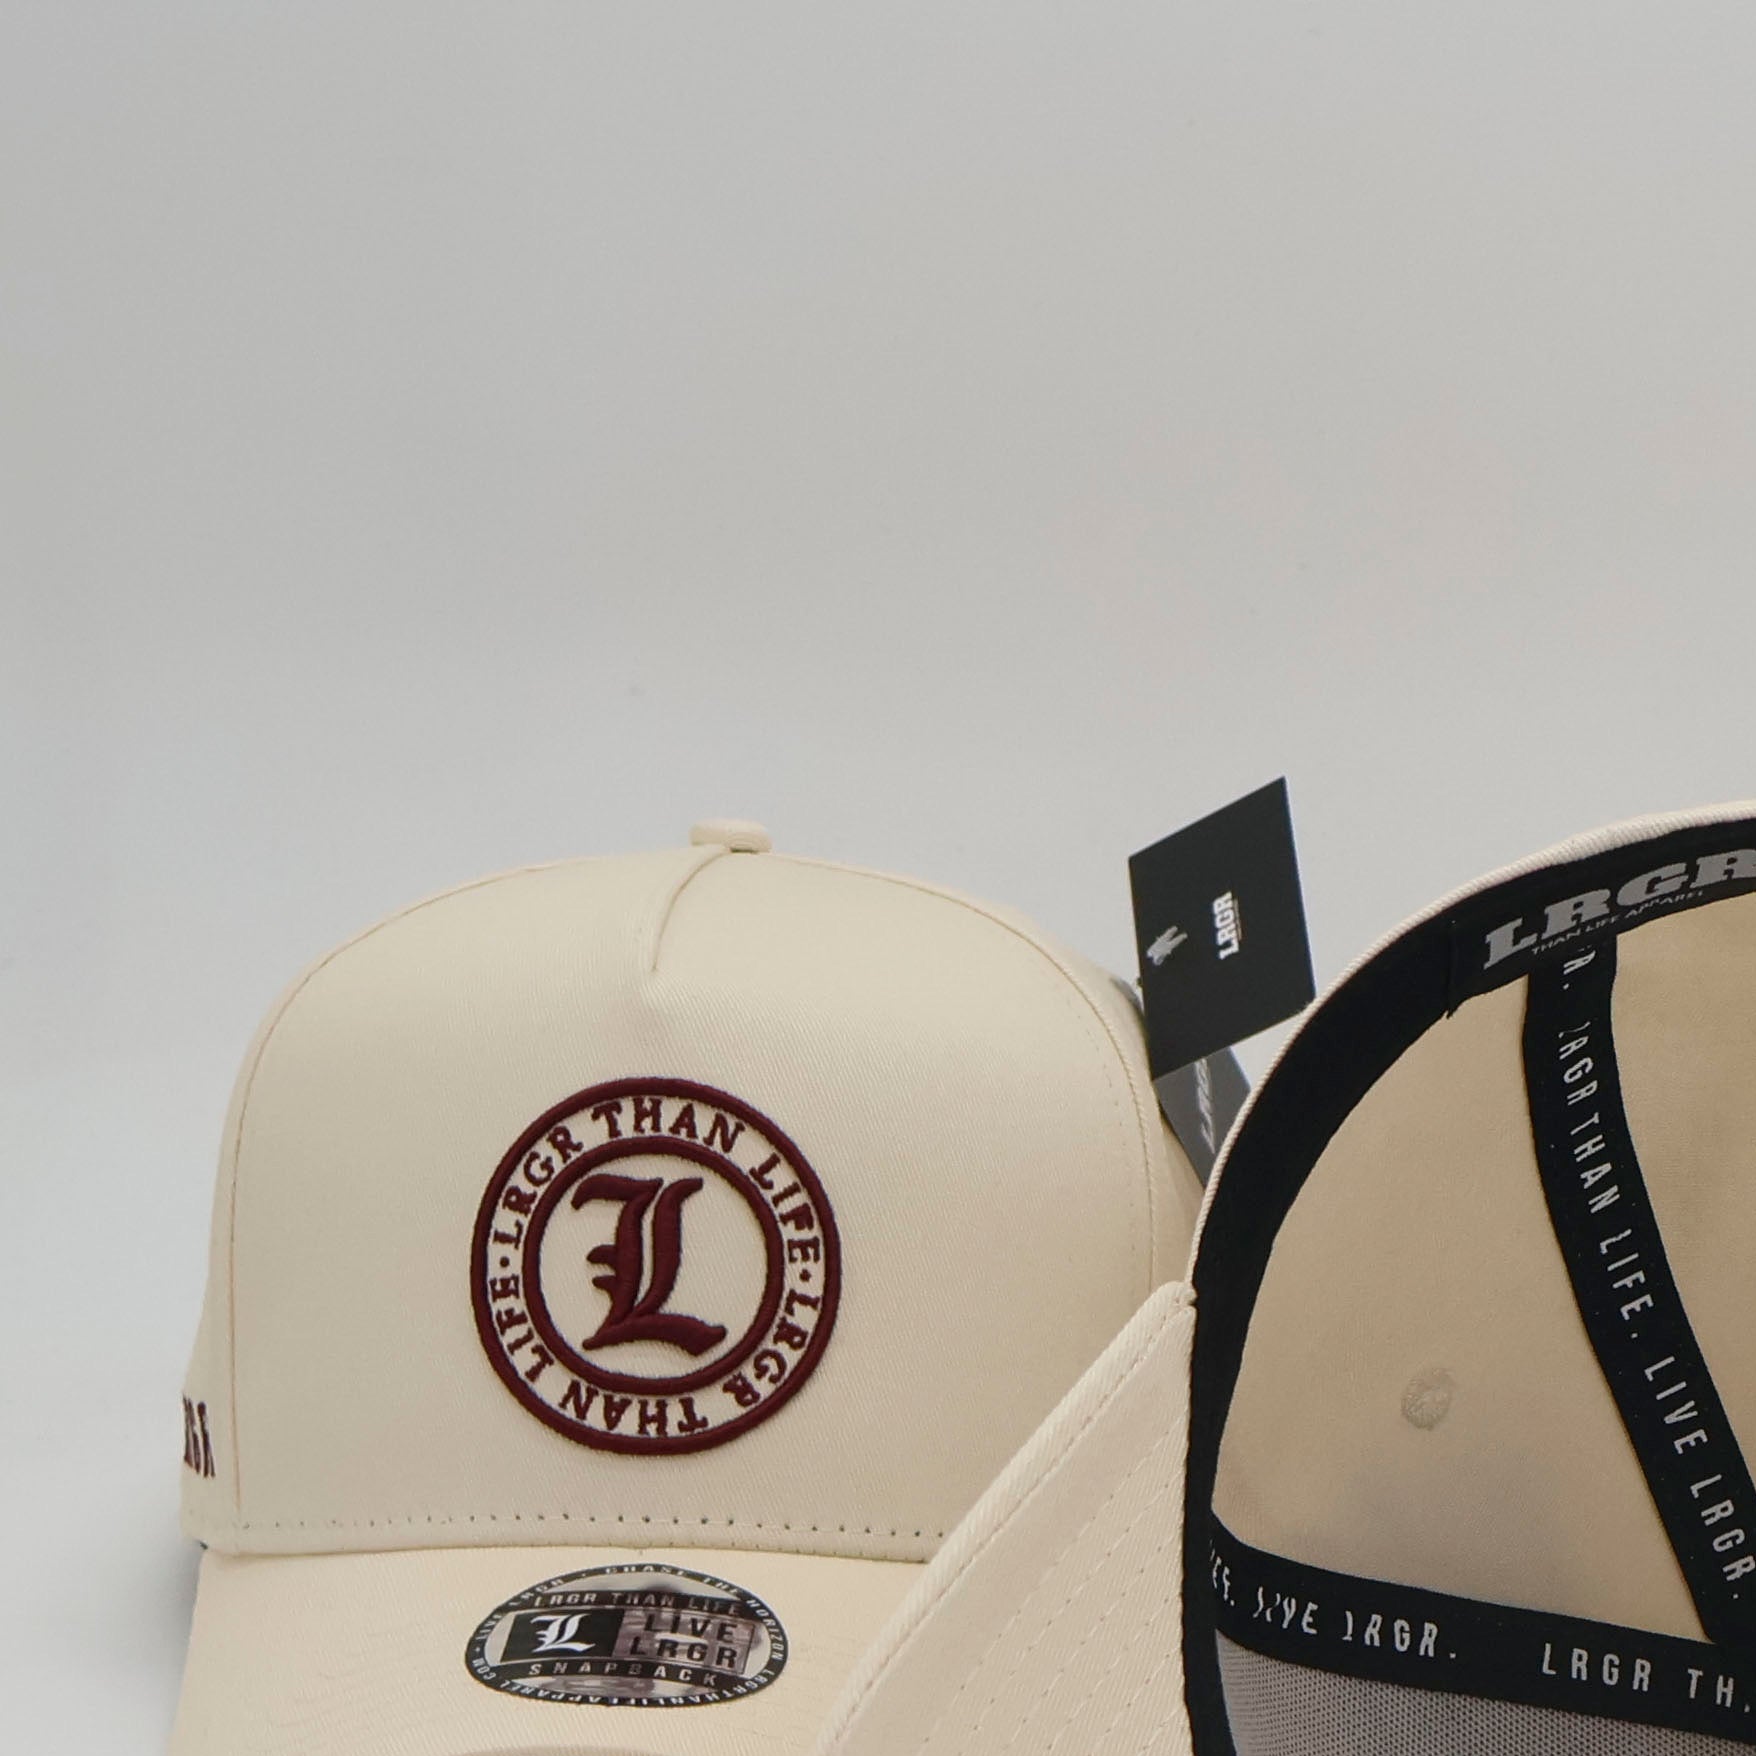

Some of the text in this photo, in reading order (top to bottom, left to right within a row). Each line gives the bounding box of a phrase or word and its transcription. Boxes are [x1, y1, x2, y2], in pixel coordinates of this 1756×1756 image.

[1213, 890, 1239, 960] LRGR
[493, 1097, 820, 1266] LRGR THAN LIFE
[570, 1172, 728, 1357] L
[1570, 1112, 1620, 1214] THAN
[1644, 1355, 1709, 1455] LIVE
[558, 1379, 709, 1436] THAN
[534, 1592, 598, 1607] LRGR
[611, 1592, 675, 1607] THAN
[530, 1613, 596, 1653] L
[629, 1636, 738, 1668] LRGR
[644, 1613, 738, 1643] LIVE
[528, 1662, 718, 1686] SNAPBACK
[1542, 1643, 1651, 1692] LRGR
